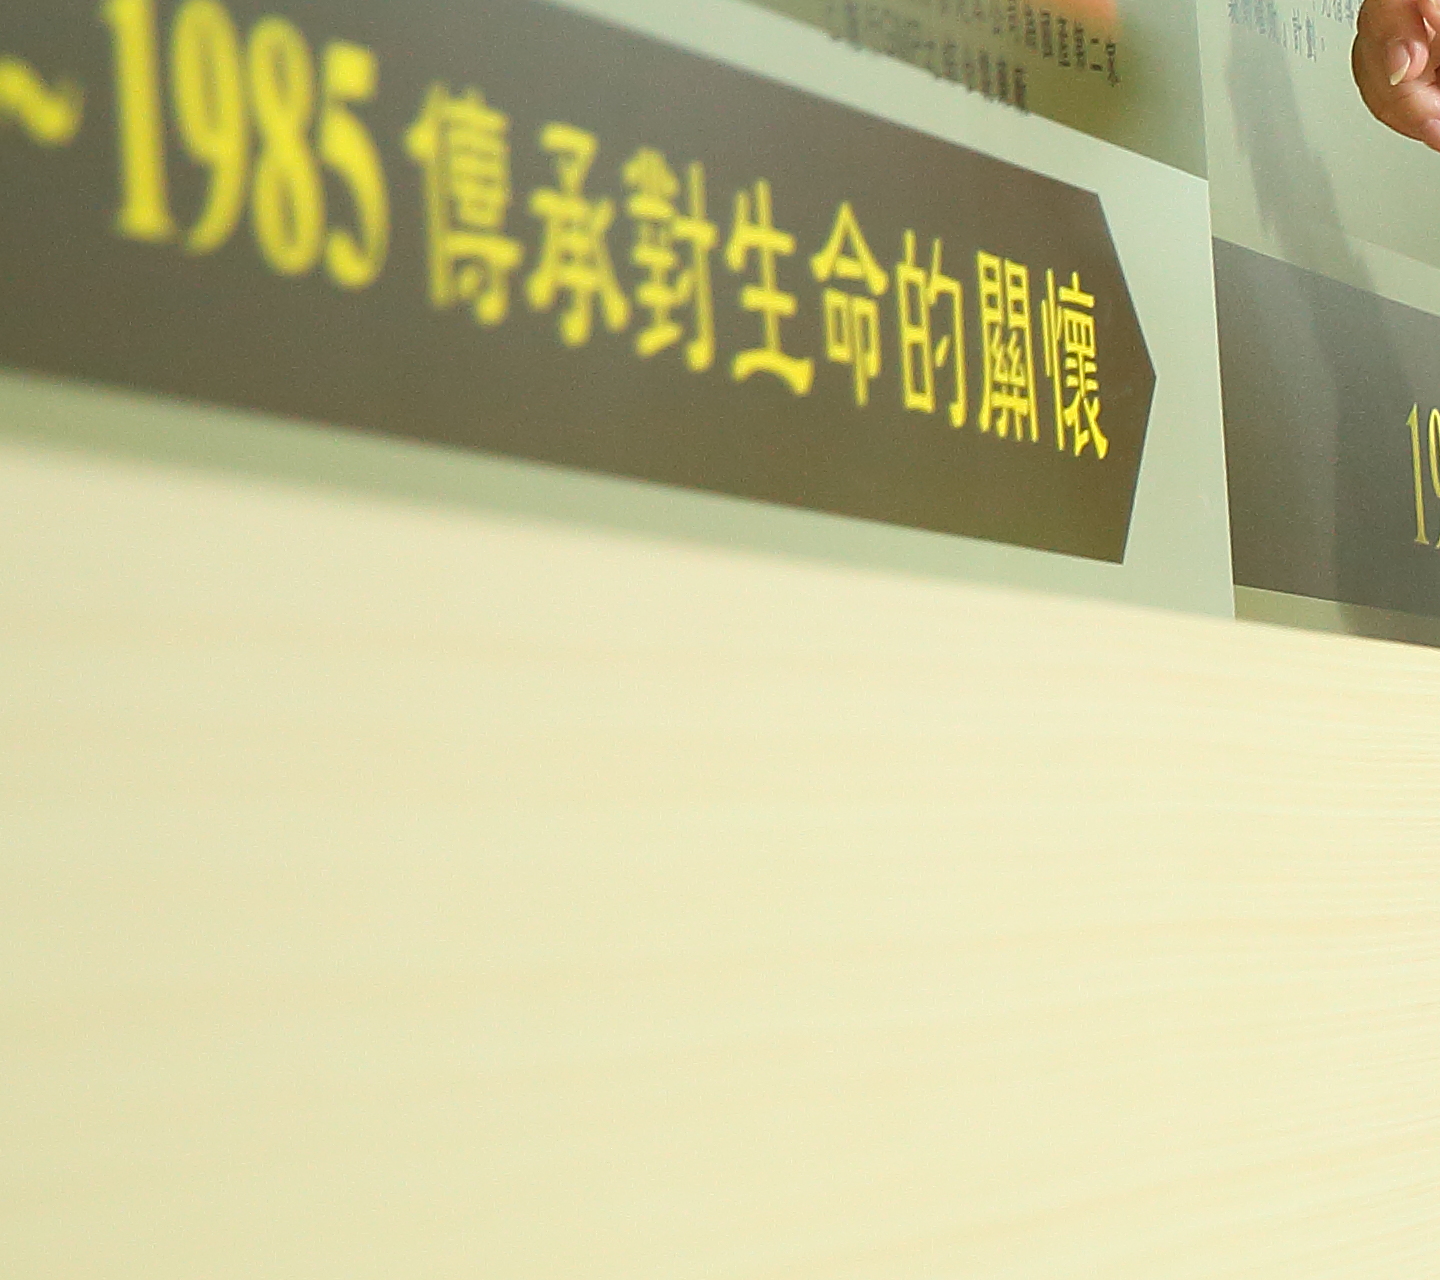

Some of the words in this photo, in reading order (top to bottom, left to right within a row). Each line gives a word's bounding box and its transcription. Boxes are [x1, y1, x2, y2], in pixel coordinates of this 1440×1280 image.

[404, 82, 1111, 460] 傳承對生命的關懷
